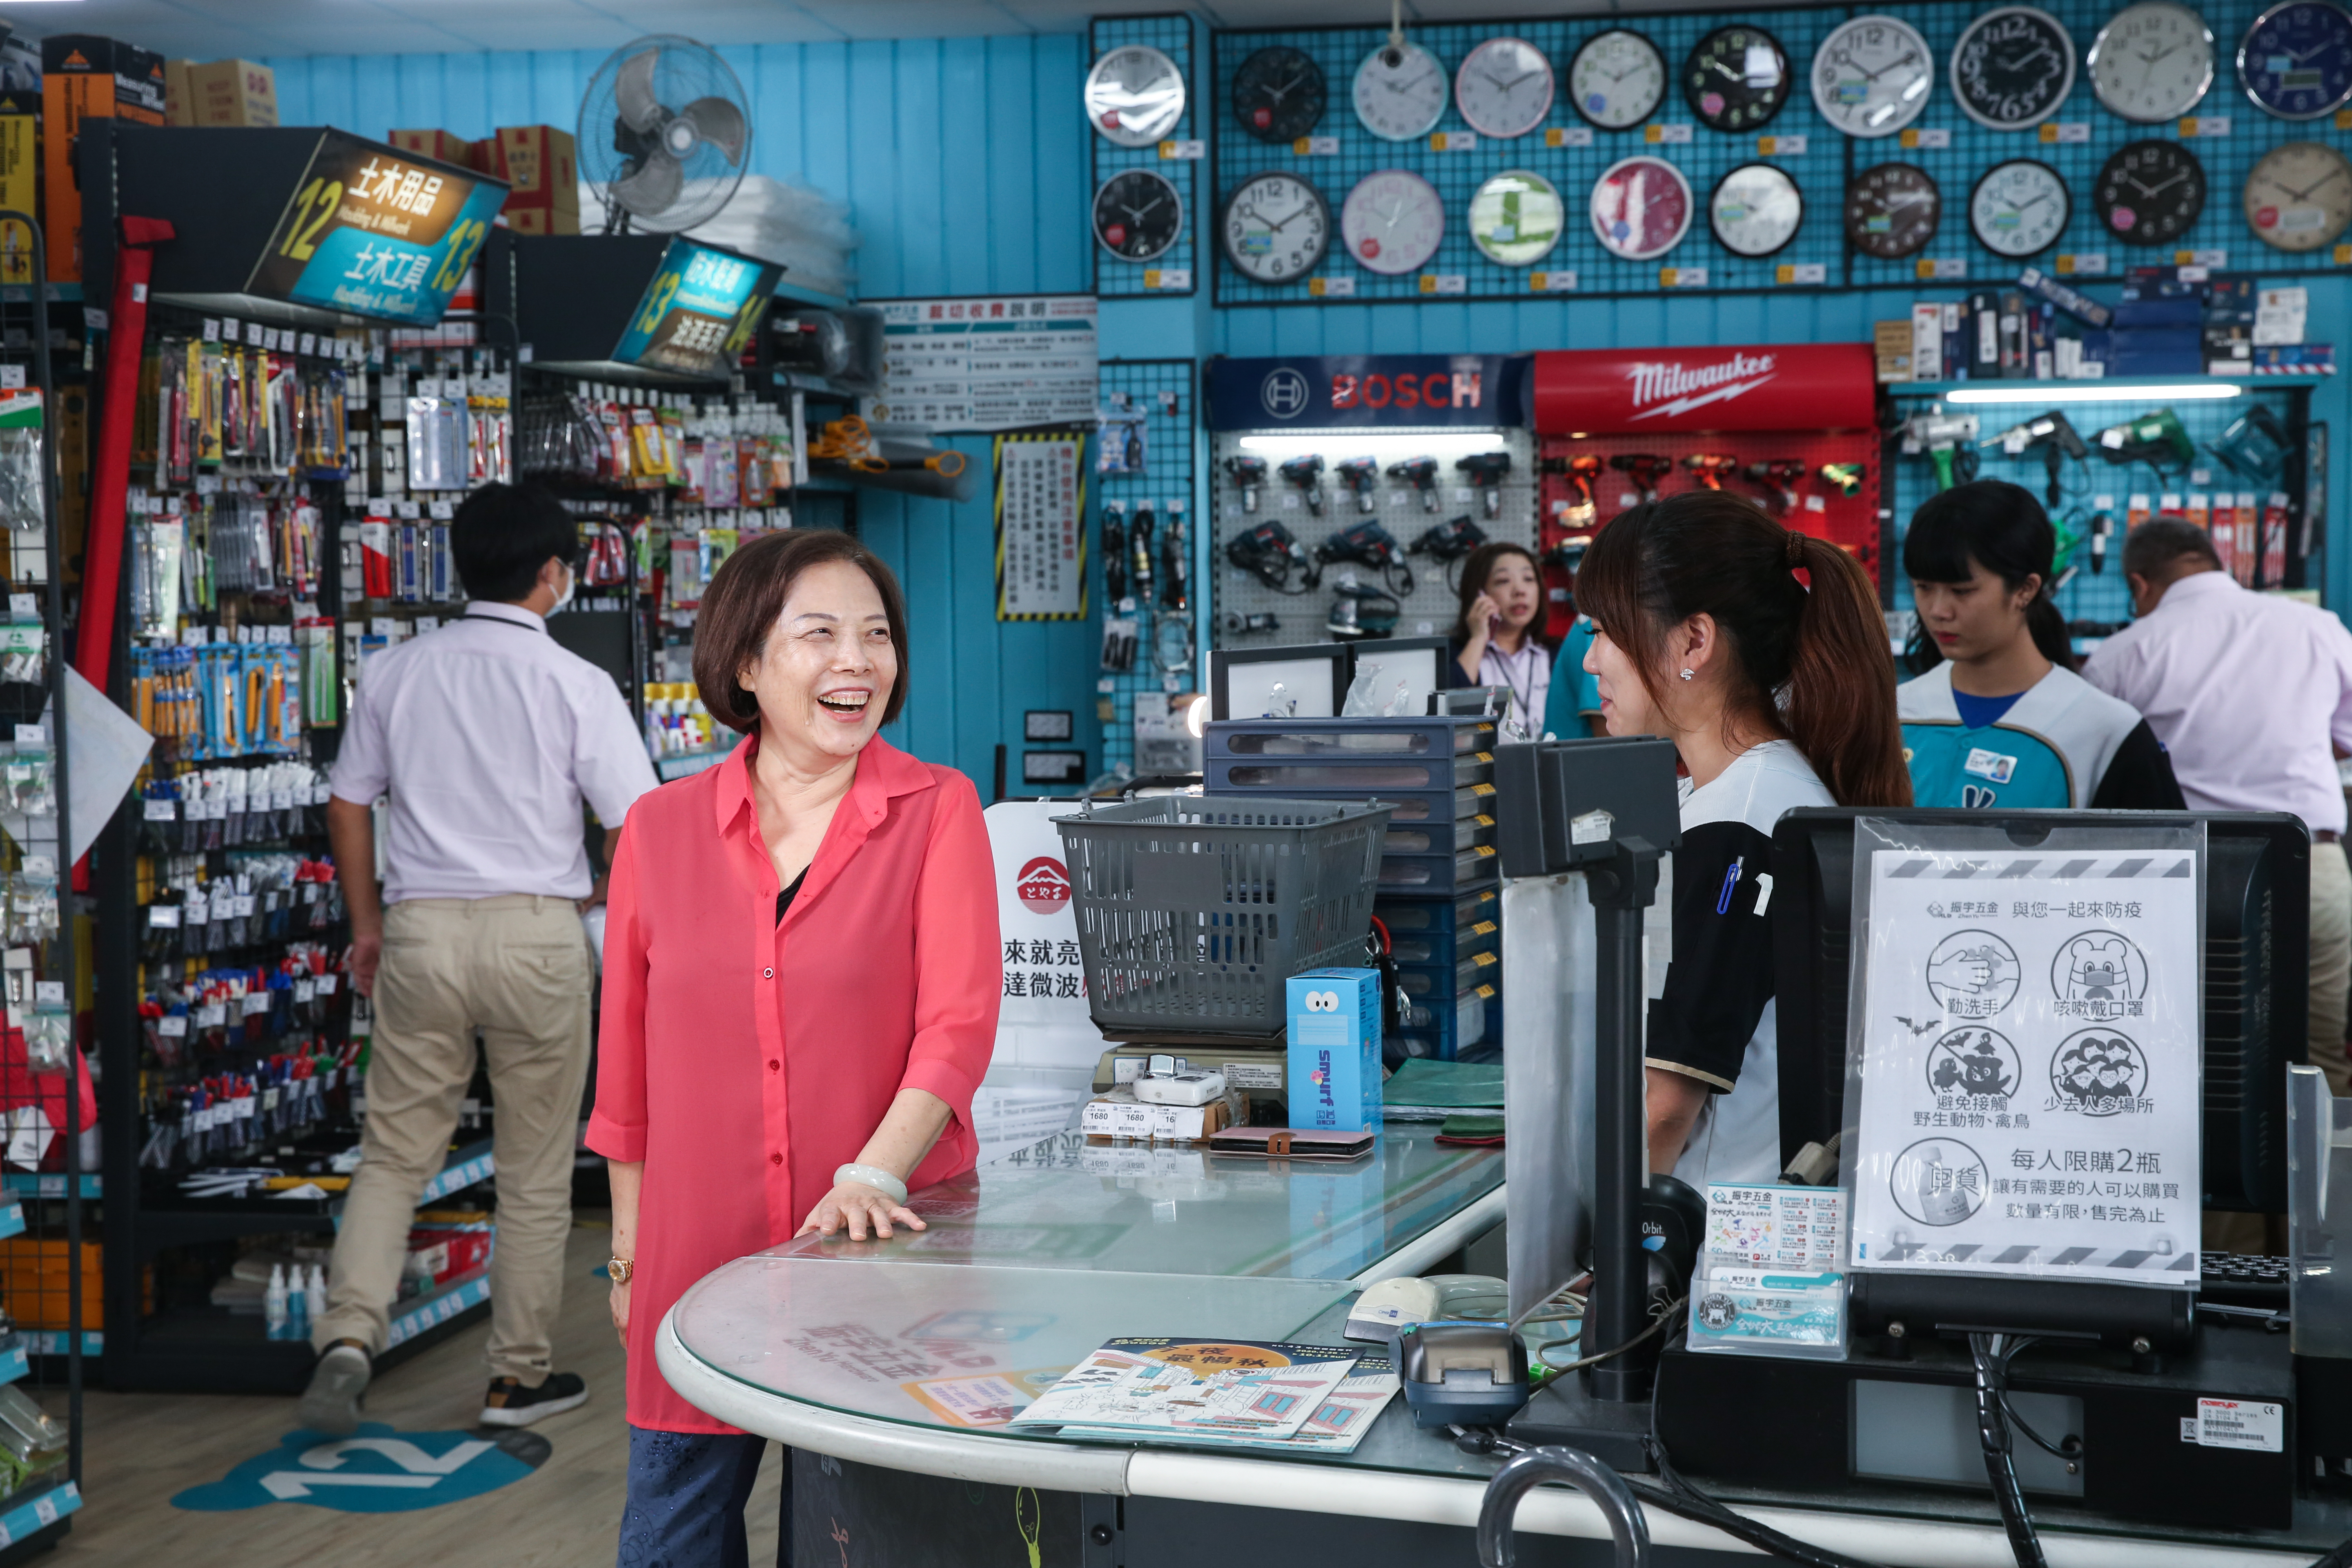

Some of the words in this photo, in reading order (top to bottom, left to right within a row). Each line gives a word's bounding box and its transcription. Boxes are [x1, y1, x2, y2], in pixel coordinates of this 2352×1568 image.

[2003, 16, 2028, 37] 12
[1963, 59, 1980, 76] 9
[2046, 52, 2060, 73] 3
[2004, 98, 2020, 119] 6
[348, 157, 443, 217] 土木用品
[1251, 189, 1264, 203] 11
[1267, 180, 1283, 197] 12
[279, 177, 344, 261] 12
[1237, 204, 1253, 218] 10
[1311, 219, 1321, 233] 3
[431, 218, 486, 292] 13
[1292, 253, 1303, 268] 5
[344, 242, 432, 293] 土木工具
[1272, 259, 1283, 274] 6
[635, 270, 681, 334] 13
[1625, 353, 1775, 408] Milwaukee
[1331, 373, 1481, 409] BOSCH
[1027, 886, 1062, 900] とやま
[1951, 902, 1998, 913] 振宇五金
[2012, 900, 2142, 919] 與您一起來防疫
[1004, 940, 1079, 966] 來就亮
[1004, 972, 1089, 999] 達微波
[1947, 998, 1999, 1016] 勤洗手
[2053, 1000, 2145, 1018] 咳嗽戴口罩
[1319, 1050, 1334, 1107] smurf
[1936, 1095, 2008, 1112] 避免接觸
[2044, 1097, 2154, 1114] 少去人多場所
[1913, 1112, 2031, 1129] 野生動物、禽鳥
[2010, 1148, 2162, 1174] 每人限購2瓶
[1732, 1191, 1772, 1202] 振宇五金
[1993, 1178, 2180, 1200] 讓有需要的人可以購買
[1642, 1222, 1662, 1234] Orbit
[1757, 1298, 1792, 1308] 振宇五金
[258, 1437, 499, 1499] 12
